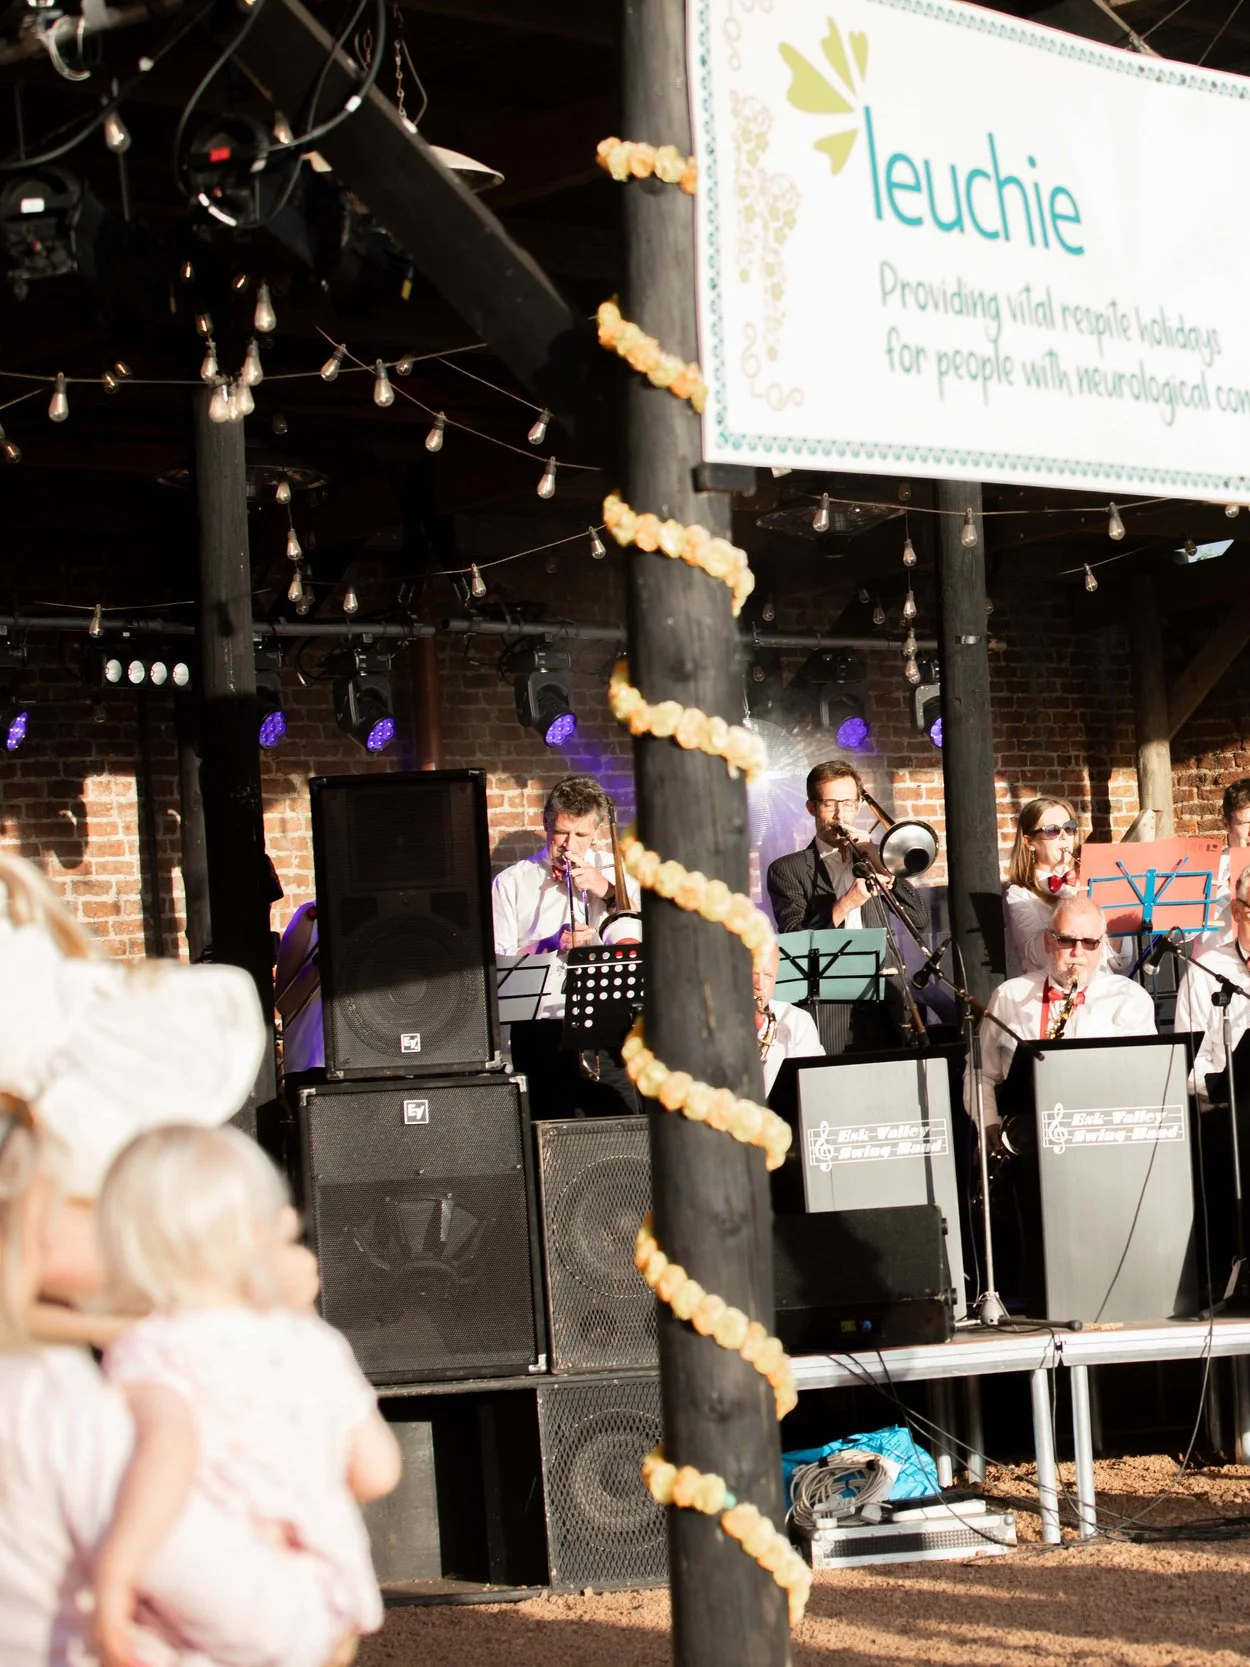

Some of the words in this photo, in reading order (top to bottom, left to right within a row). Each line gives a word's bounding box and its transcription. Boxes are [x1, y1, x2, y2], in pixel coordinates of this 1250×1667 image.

[864, 105, 1085, 255] leuchie
[880, 260, 1001, 343] Providing
[1007, 283, 1056, 330] vital
[1061, 298, 1132, 359] respite
[1135, 305, 1222, 368] holidays
[886, 326, 928, 374] for
[937, 340, 1014, 405] people
[1022, 348, 1073, 397] with
[1076, 360, 1210, 427] neurological
[407, 1103, 426, 1121] EV
[1112, 1110, 1168, 1125] Valley
[876, 1125, 931, 1140] Valley
[1071, 1129, 1127, 1144] Swing
[1131, 1125, 1179, 1141] Band
[838, 1145, 892, 1160] Swing
[896, 1138, 944, 1156] Band
